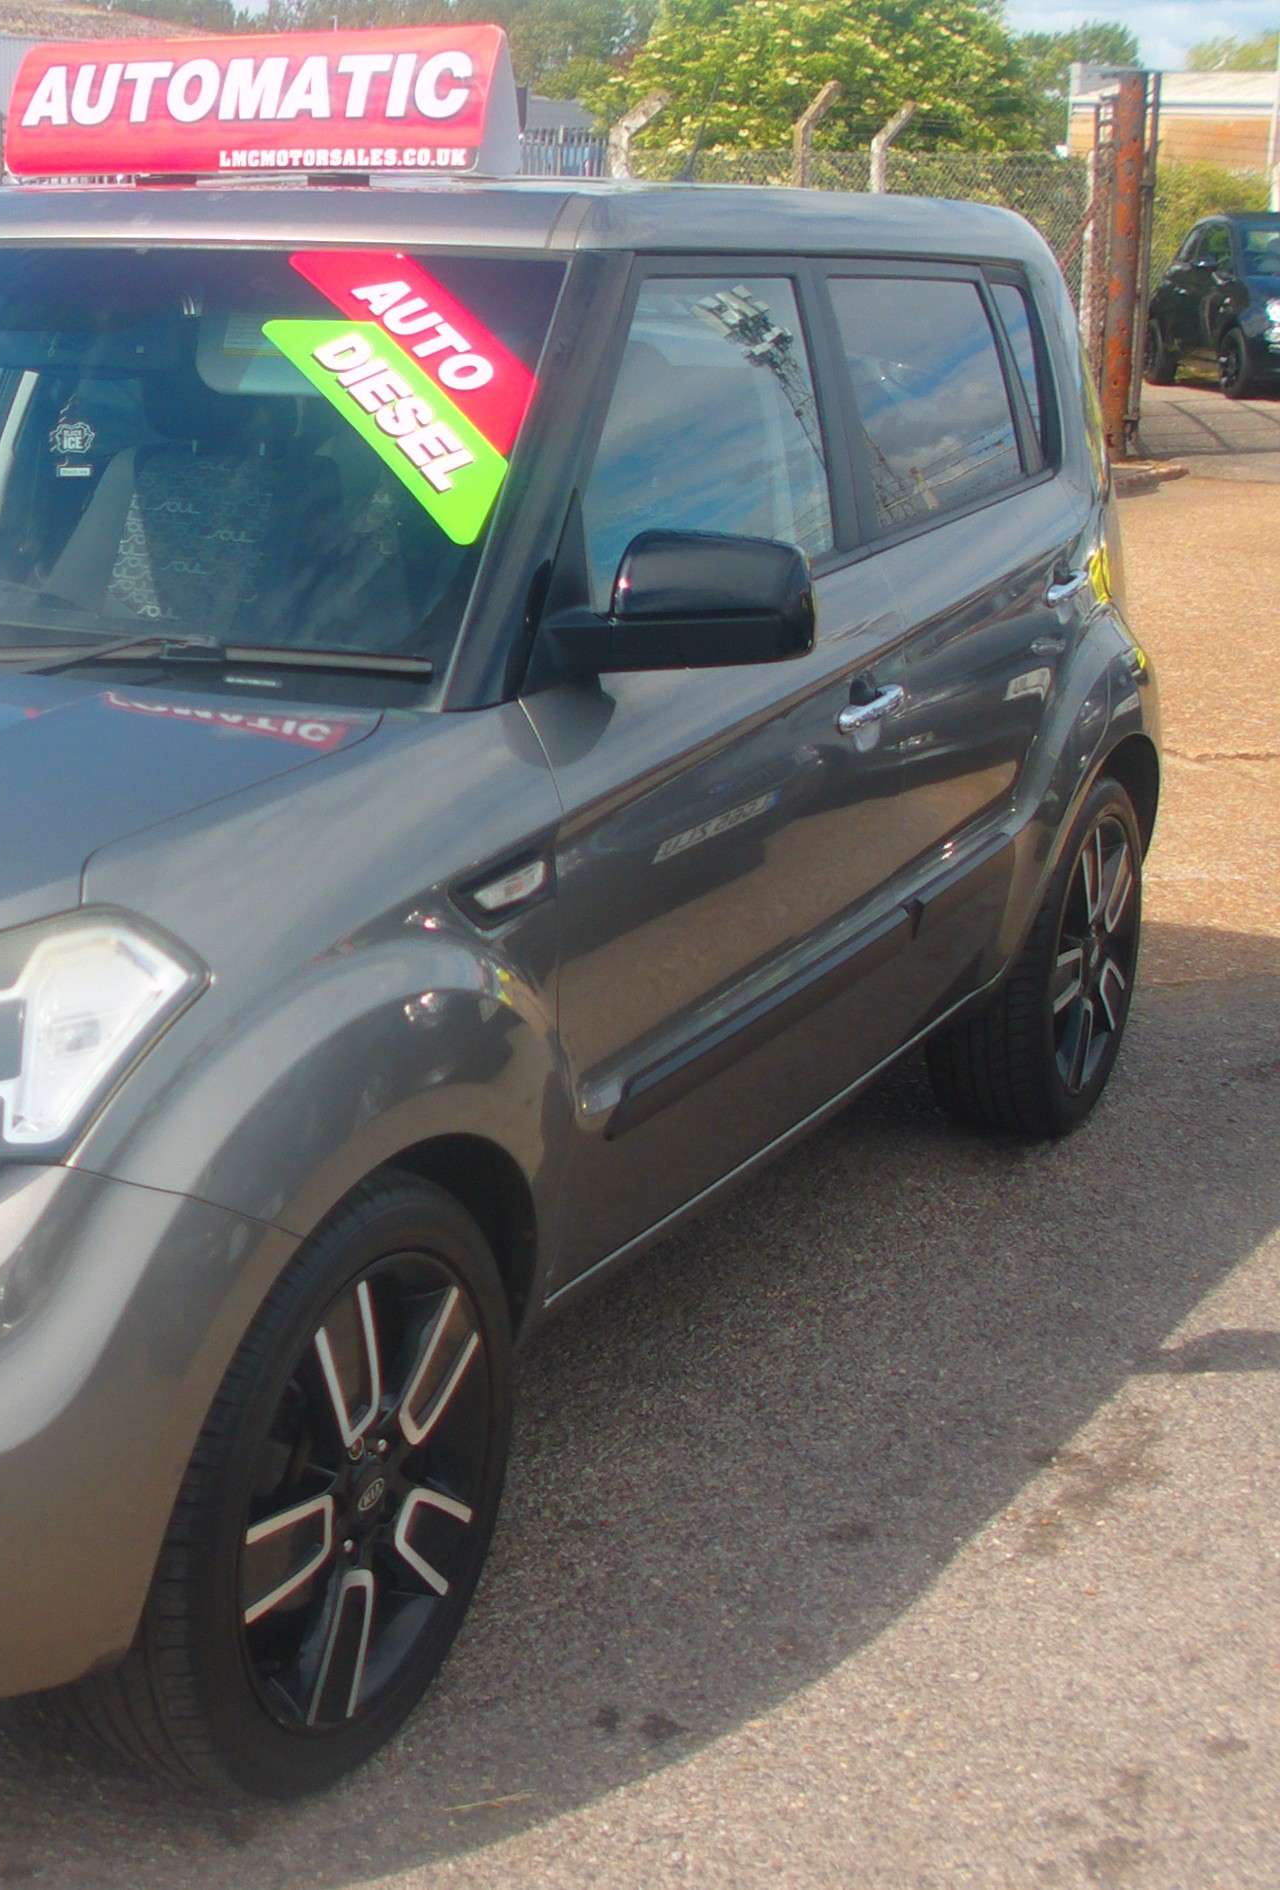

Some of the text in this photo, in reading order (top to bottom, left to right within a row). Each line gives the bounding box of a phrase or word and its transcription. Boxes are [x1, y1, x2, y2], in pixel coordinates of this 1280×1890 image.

[20, 50, 473, 128] AUTOMATIC
[219, 147, 466, 168] LMCMOTORSALES.CO.UK
[351, 280, 494, 390] AUTO
[63, 436, 83, 449] ICE
[312, 332, 474, 494] DIESEL
